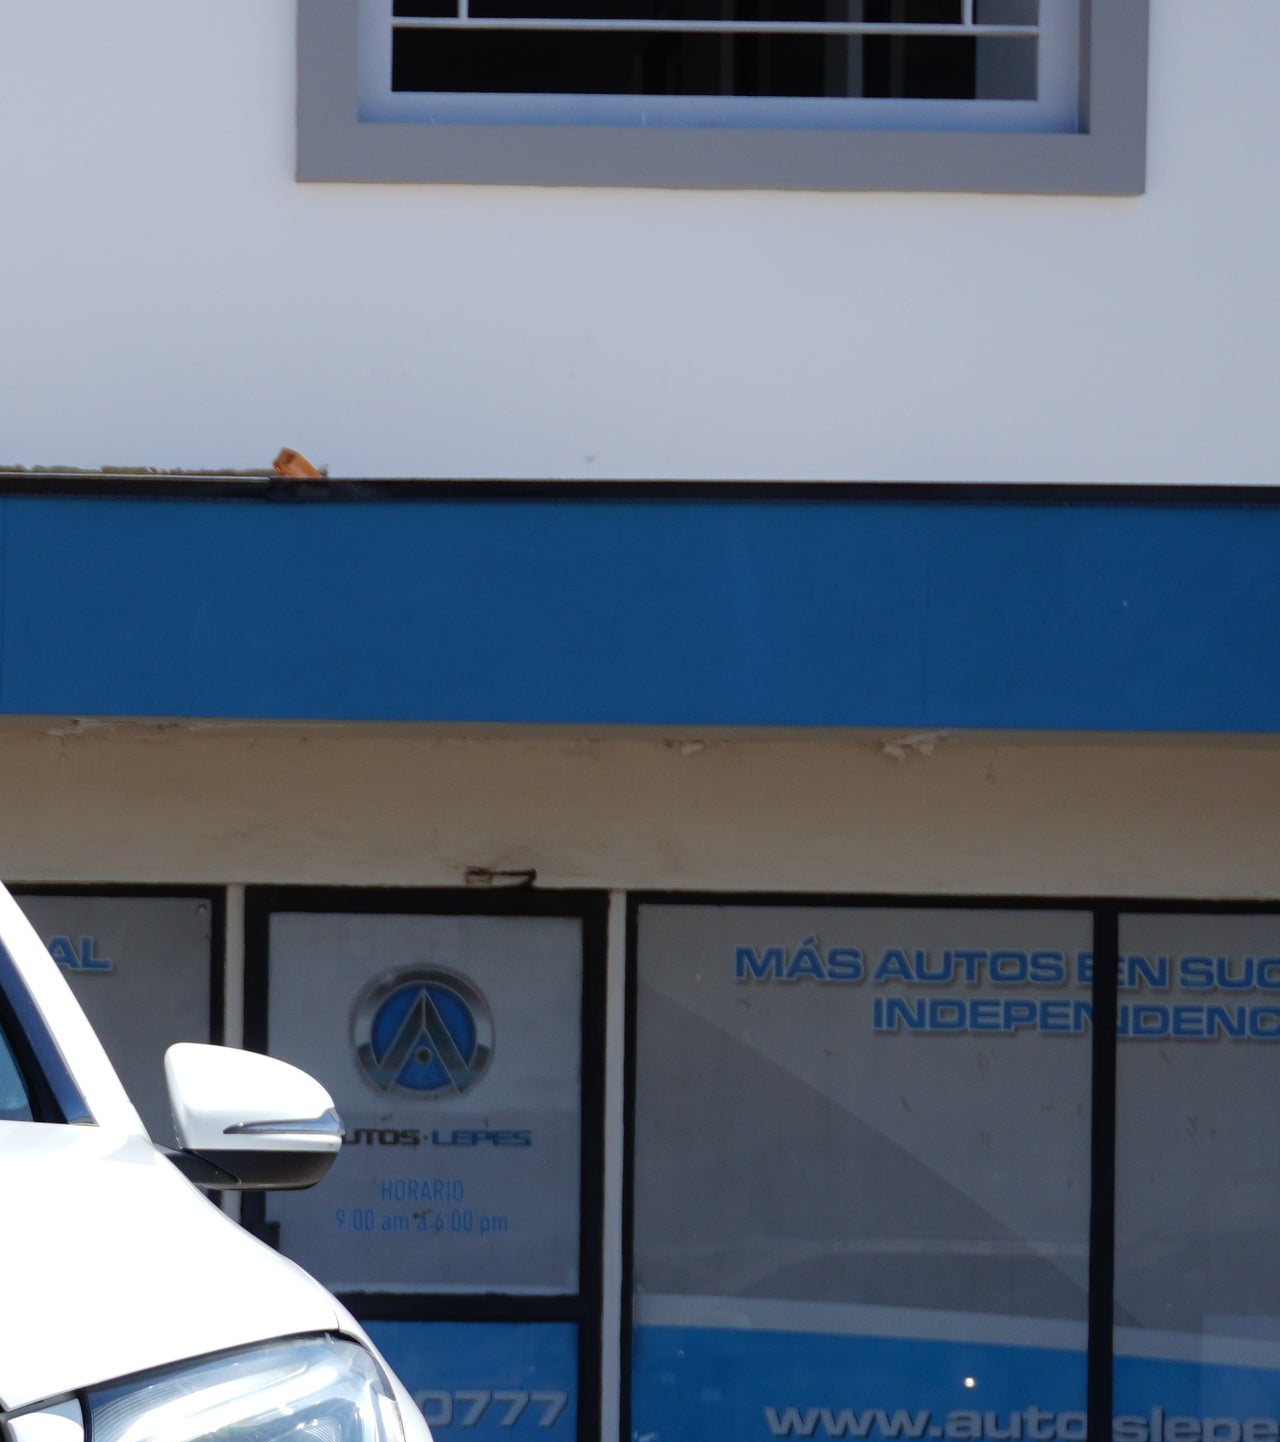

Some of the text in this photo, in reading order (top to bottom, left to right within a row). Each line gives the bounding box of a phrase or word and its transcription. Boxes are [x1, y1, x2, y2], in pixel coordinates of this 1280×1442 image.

[734, 933, 863, 983] MÁS
[873, 948, 1065, 985] AUTOS
[380, 1179, 465, 1201] HORARIO
[381, 1214, 410, 1232] am
[480, 1214, 509, 1236] pm
